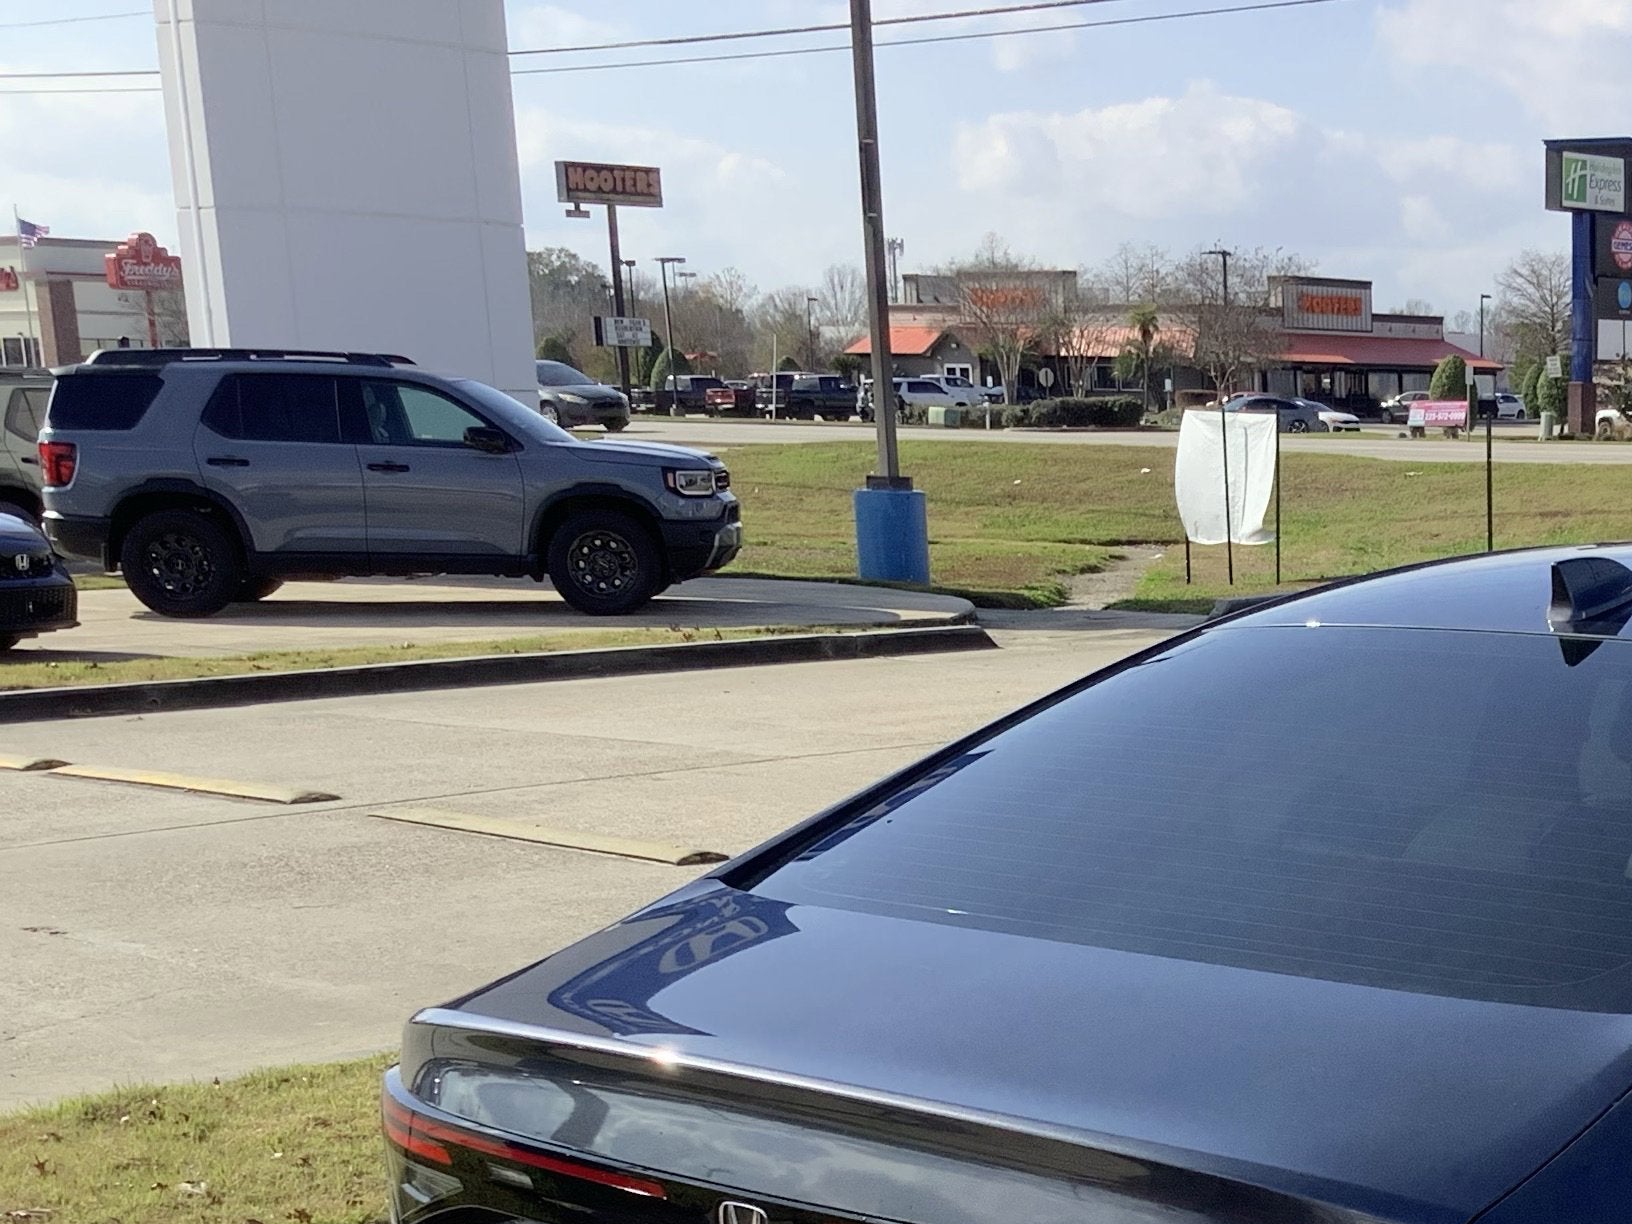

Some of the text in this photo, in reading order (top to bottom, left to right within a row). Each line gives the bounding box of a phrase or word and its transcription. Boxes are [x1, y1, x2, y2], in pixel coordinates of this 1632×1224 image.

[567, 166, 659, 193] HOOTERS
[1589, 174, 1622, 193] Express
[119, 259, 181, 280] Freddy's
